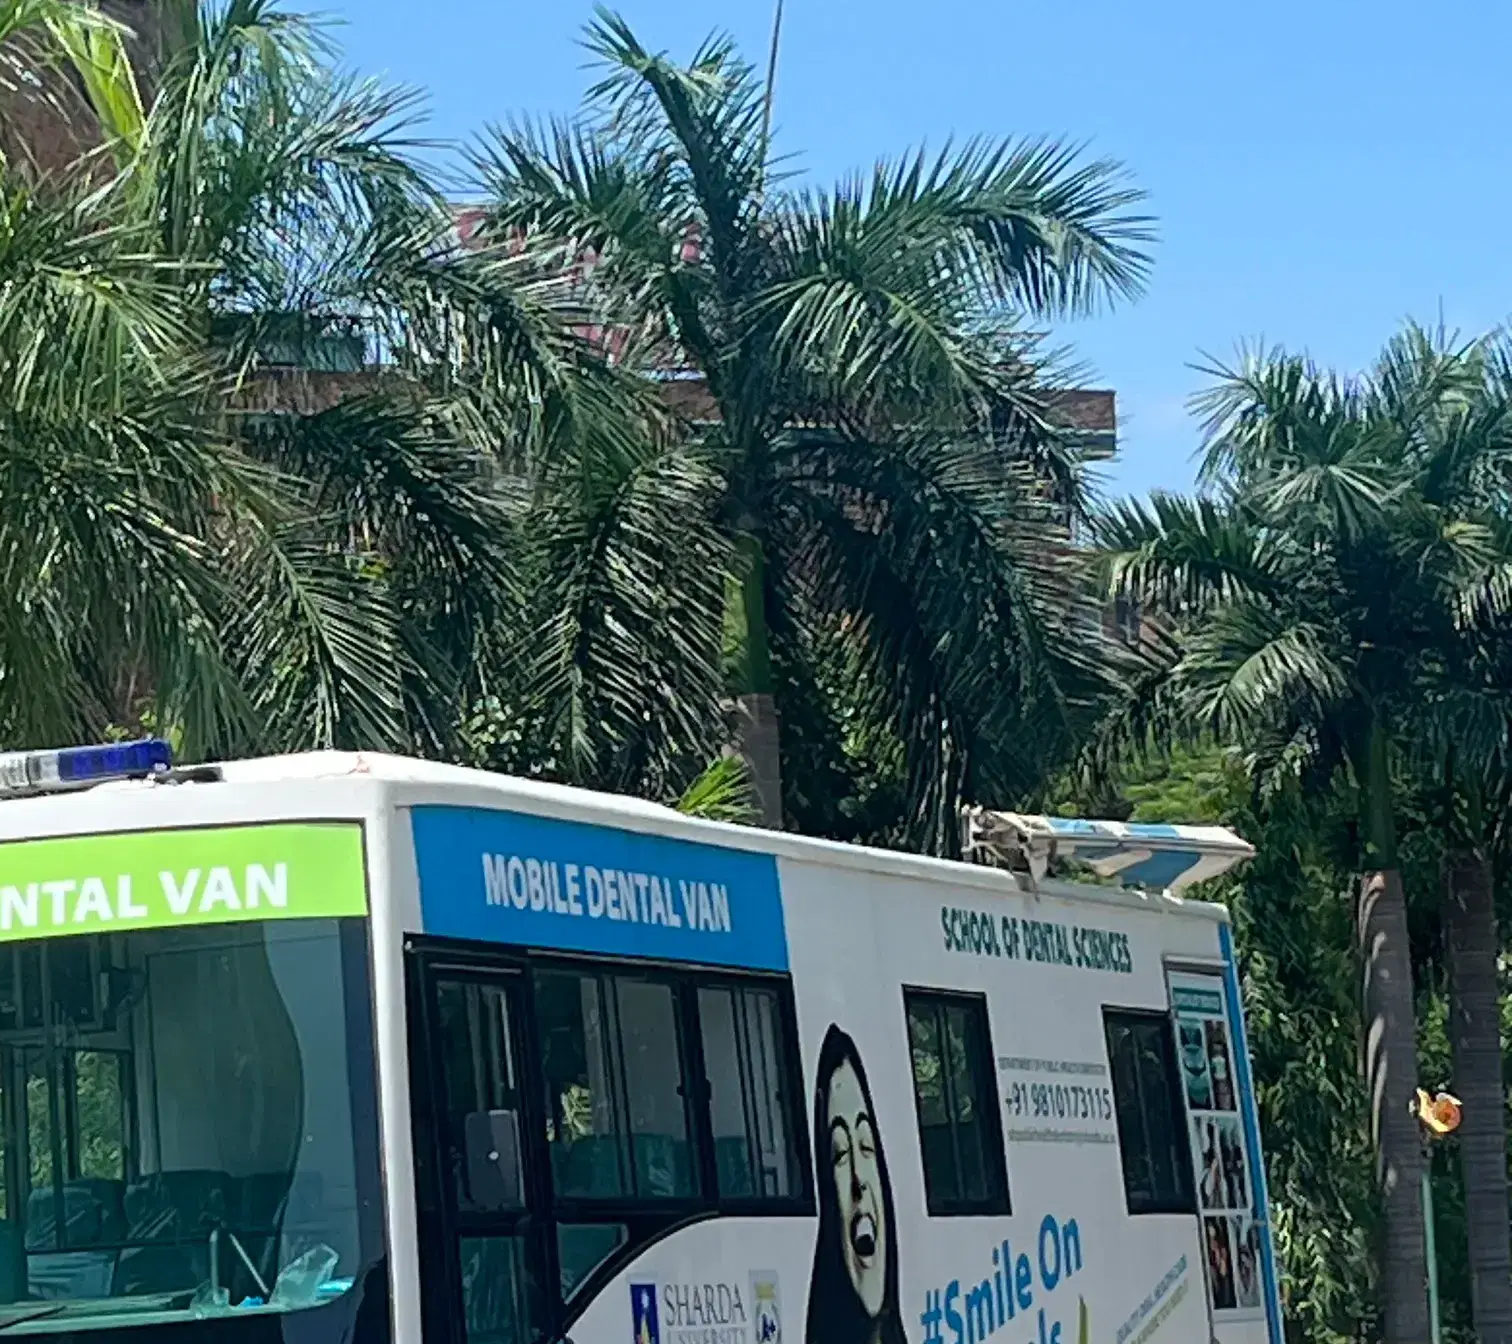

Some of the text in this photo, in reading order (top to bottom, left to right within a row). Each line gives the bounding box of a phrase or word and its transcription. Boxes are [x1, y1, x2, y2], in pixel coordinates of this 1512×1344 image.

[159, 861, 288, 916] VAN
[481, 852, 732, 933] MOBILE DENTAL VAN
[941, 906, 1133, 974] SCHOOL OF DENTAL SCIENCES
[1029, 1082, 1113, 1121] 9810173115
[1039, 1214, 1082, 1292] On
[664, 1282, 748, 1327] SHARDA
